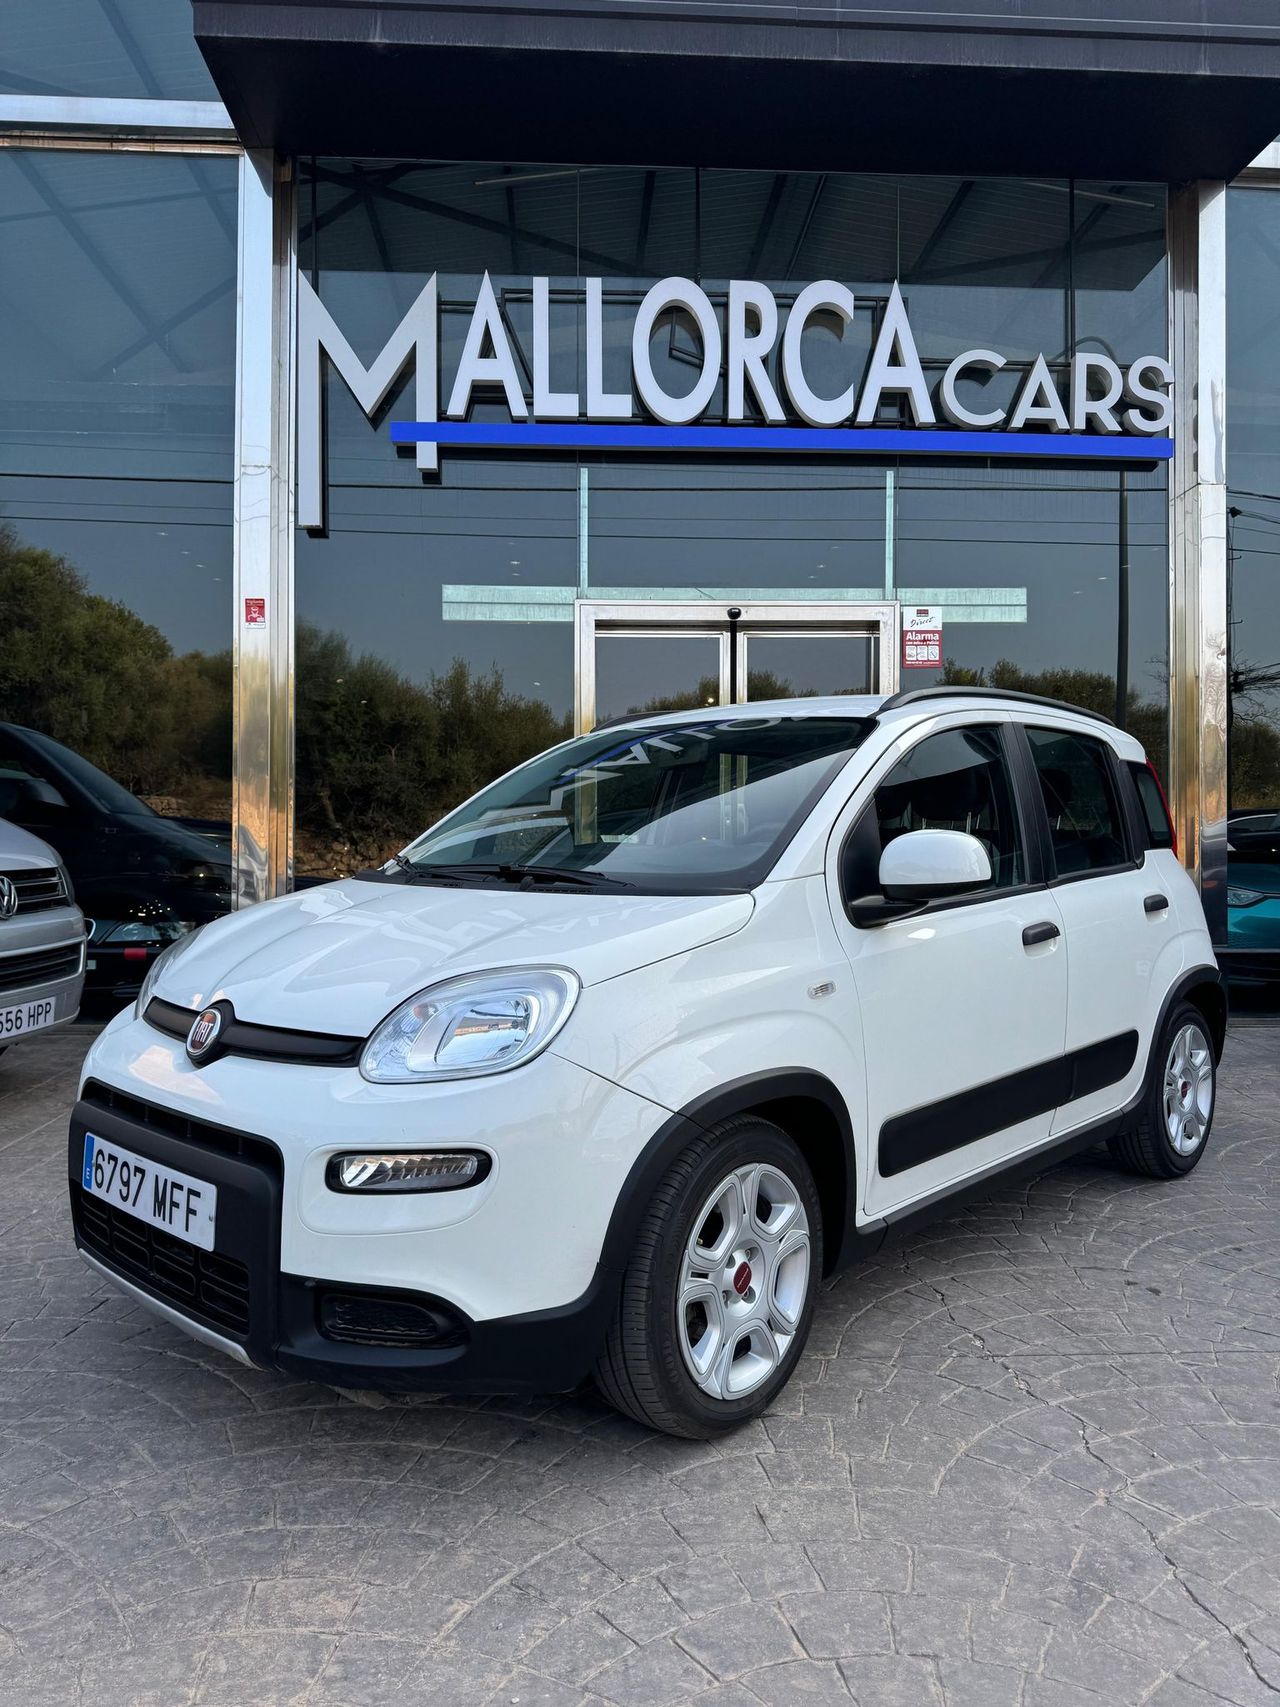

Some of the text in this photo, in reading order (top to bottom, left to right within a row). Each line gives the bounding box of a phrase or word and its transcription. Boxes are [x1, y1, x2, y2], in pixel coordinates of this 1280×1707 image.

[297, 268, 1175, 528] MALLORCA CARS
[906, 631, 940, 641] Alarma
[27, 1001, 52, 1027] HPP
[192, 1020, 215, 1043] FIAT
[94, 1148, 202, 1233] 6797 MFF
